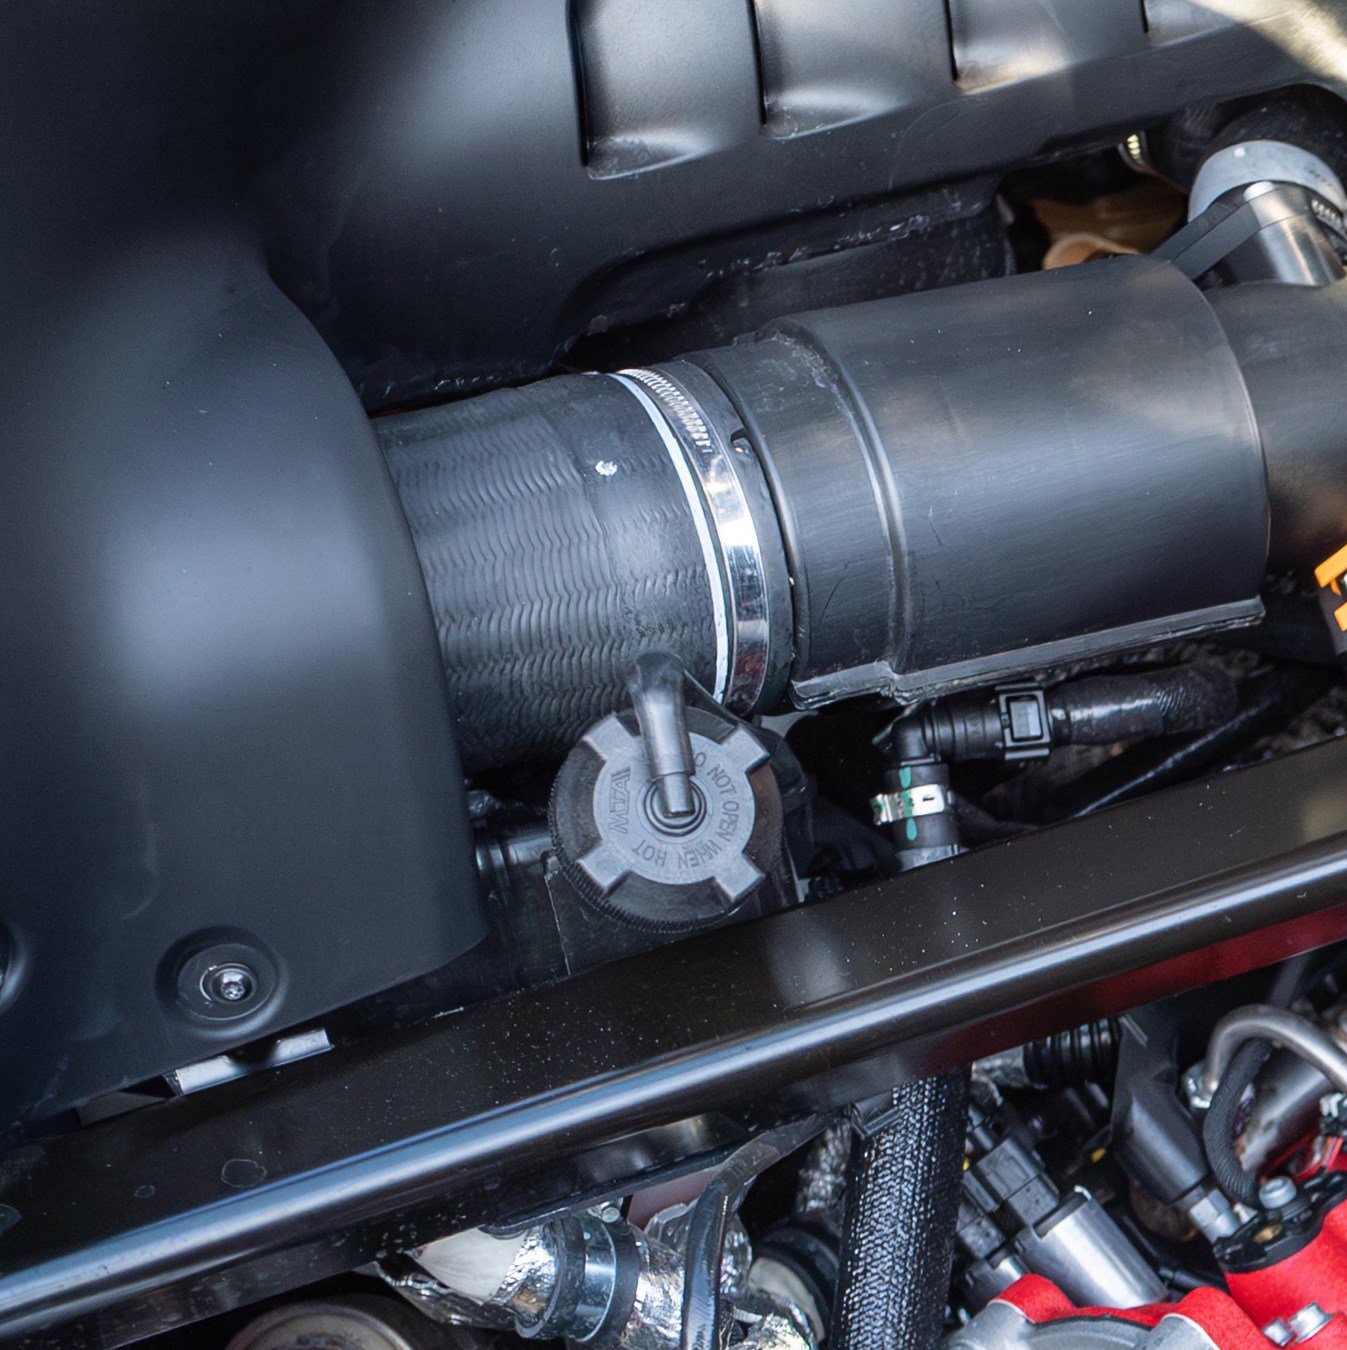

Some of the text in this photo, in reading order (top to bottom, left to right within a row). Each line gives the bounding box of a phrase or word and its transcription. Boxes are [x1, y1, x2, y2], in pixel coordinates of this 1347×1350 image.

[707, 764, 737, 795] NOT
[718, 800, 740, 842] OPEN
[632, 840, 667, 867] HOT
[676, 840, 722, 869] WHEN
